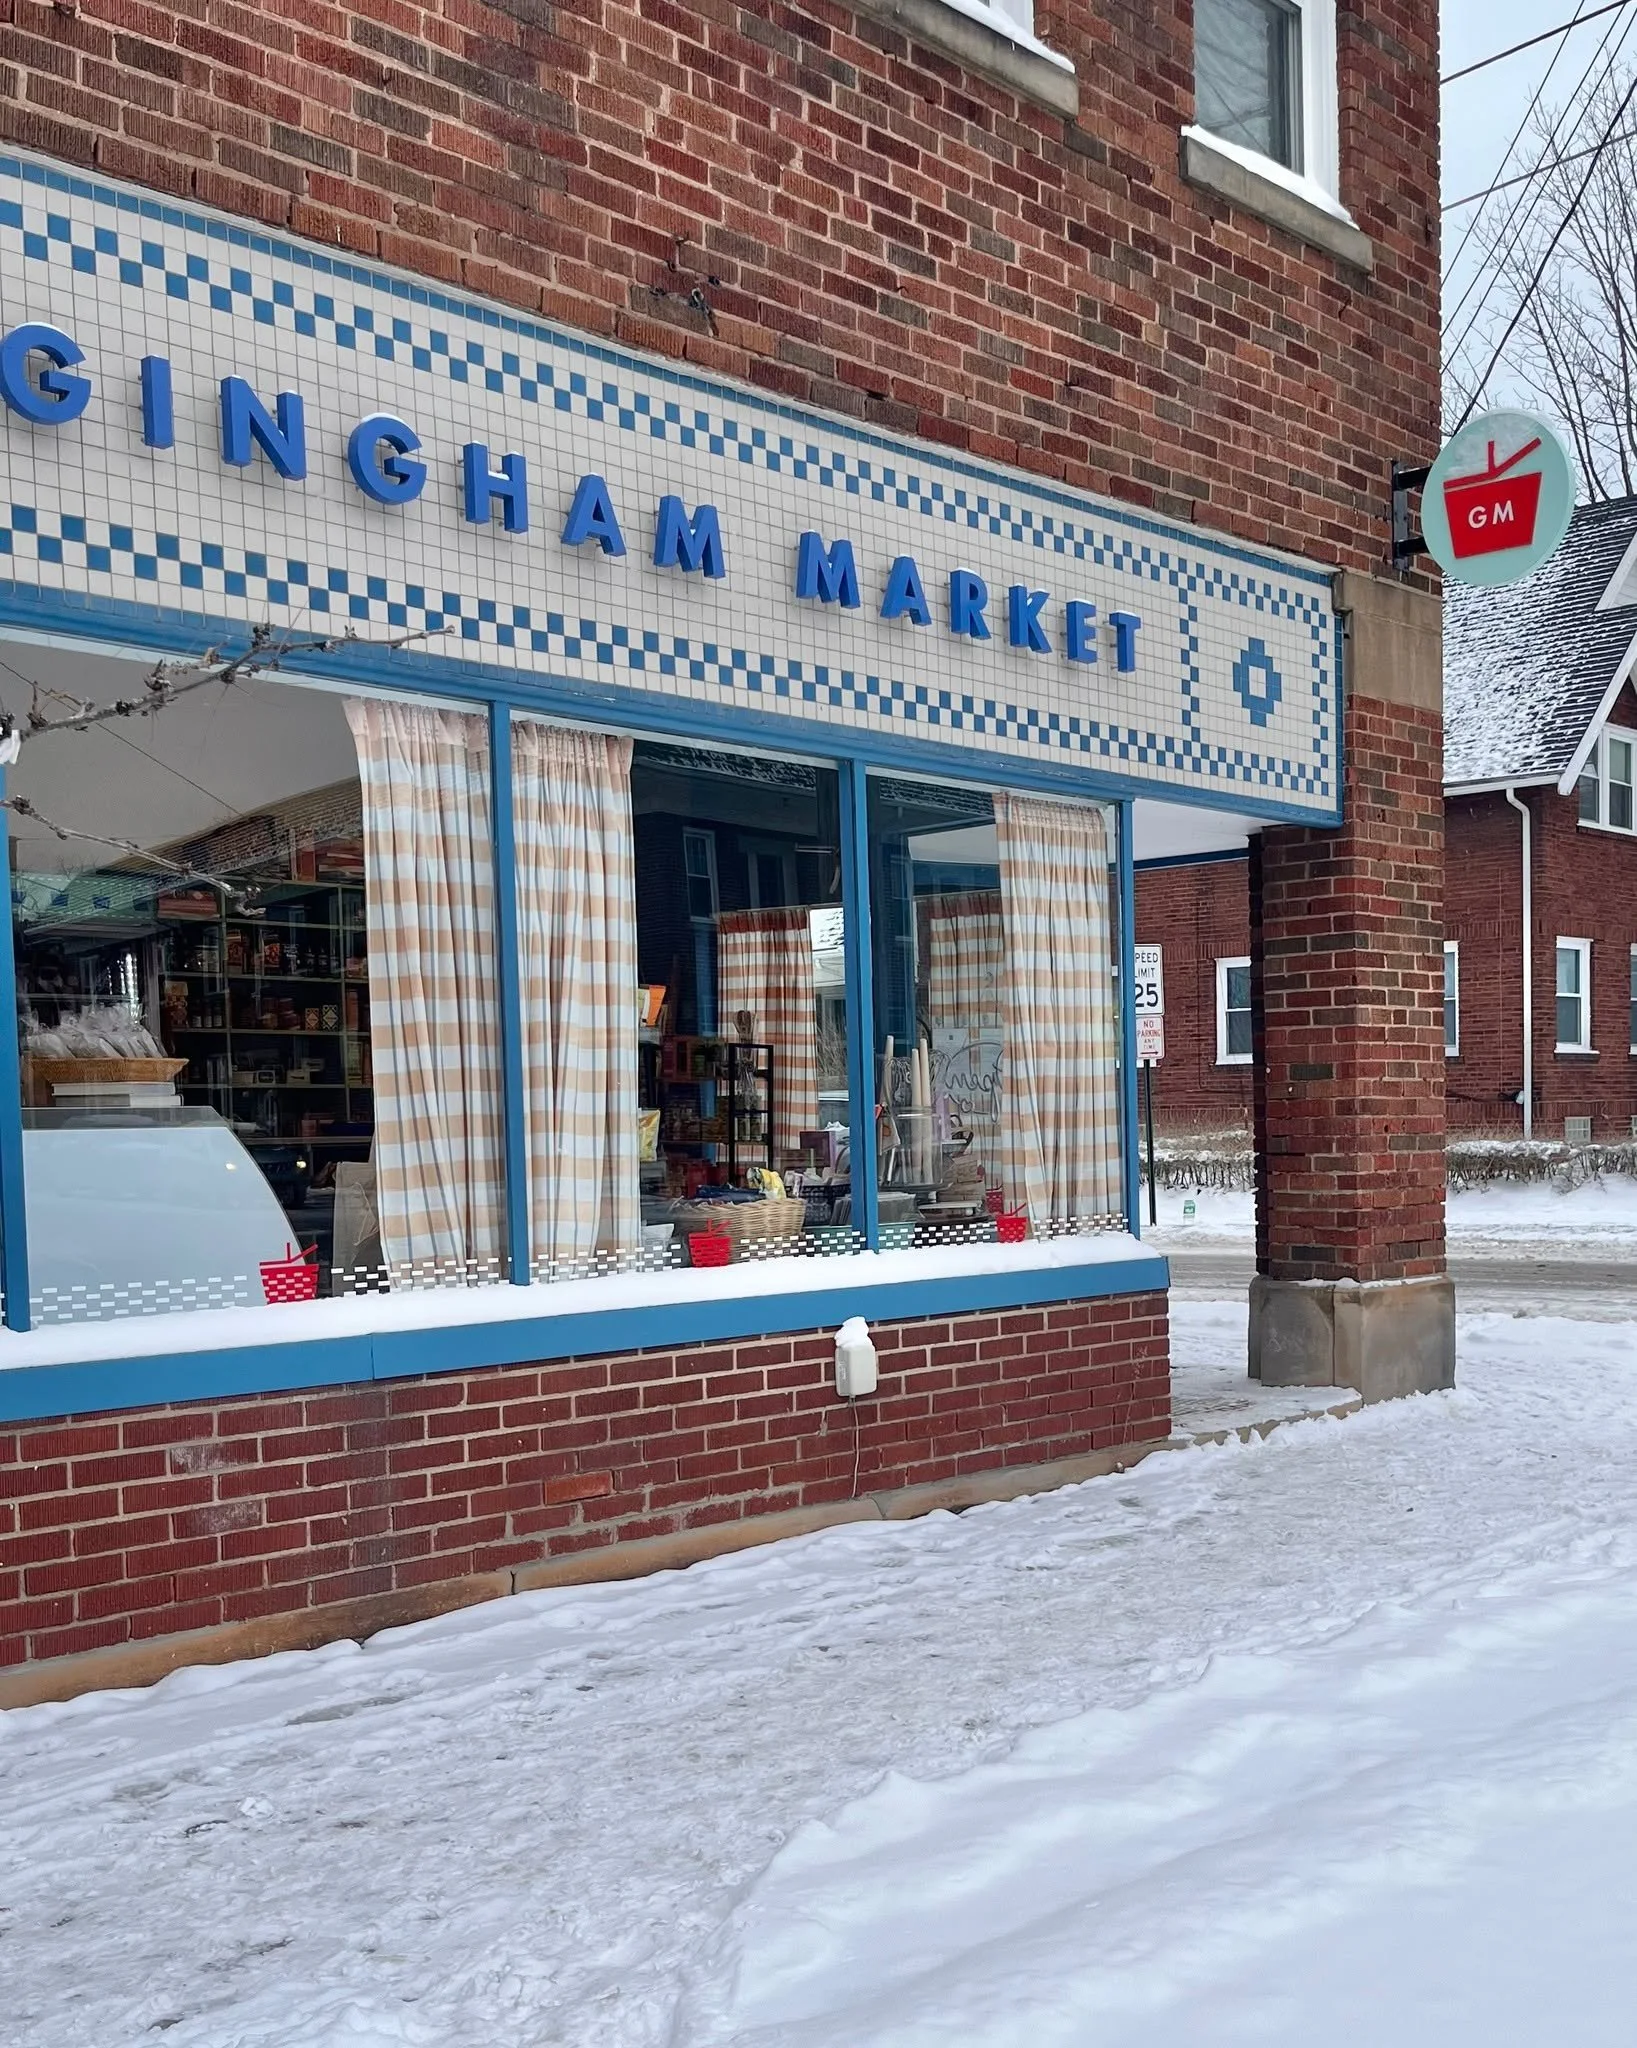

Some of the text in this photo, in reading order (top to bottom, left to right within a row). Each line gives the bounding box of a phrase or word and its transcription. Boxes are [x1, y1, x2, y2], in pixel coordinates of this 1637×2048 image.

[0, 322, 1142, 673] GINGHAM MARKET
[1468, 500, 1514, 529] GM
[1135, 952, 1158, 963] PEED
[1135, 983, 1158, 1007] 25
[1143, 1020, 1154, 1029] NO
